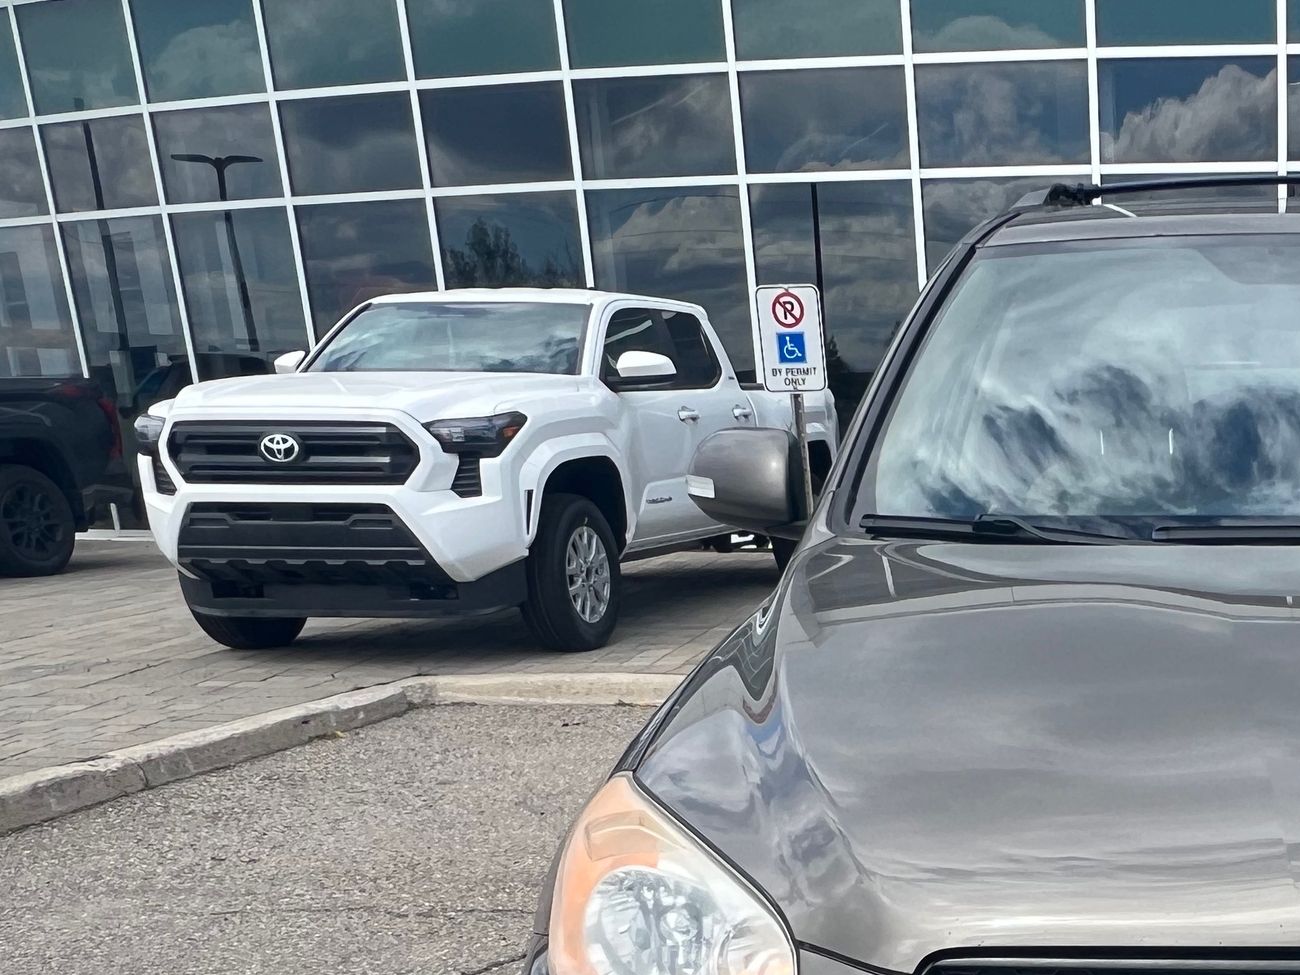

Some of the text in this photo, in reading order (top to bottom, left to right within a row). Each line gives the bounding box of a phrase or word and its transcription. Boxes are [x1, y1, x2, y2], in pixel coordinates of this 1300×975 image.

[771, 367, 816, 377] BY PERMIT
[784, 377, 806, 386] ONLY
